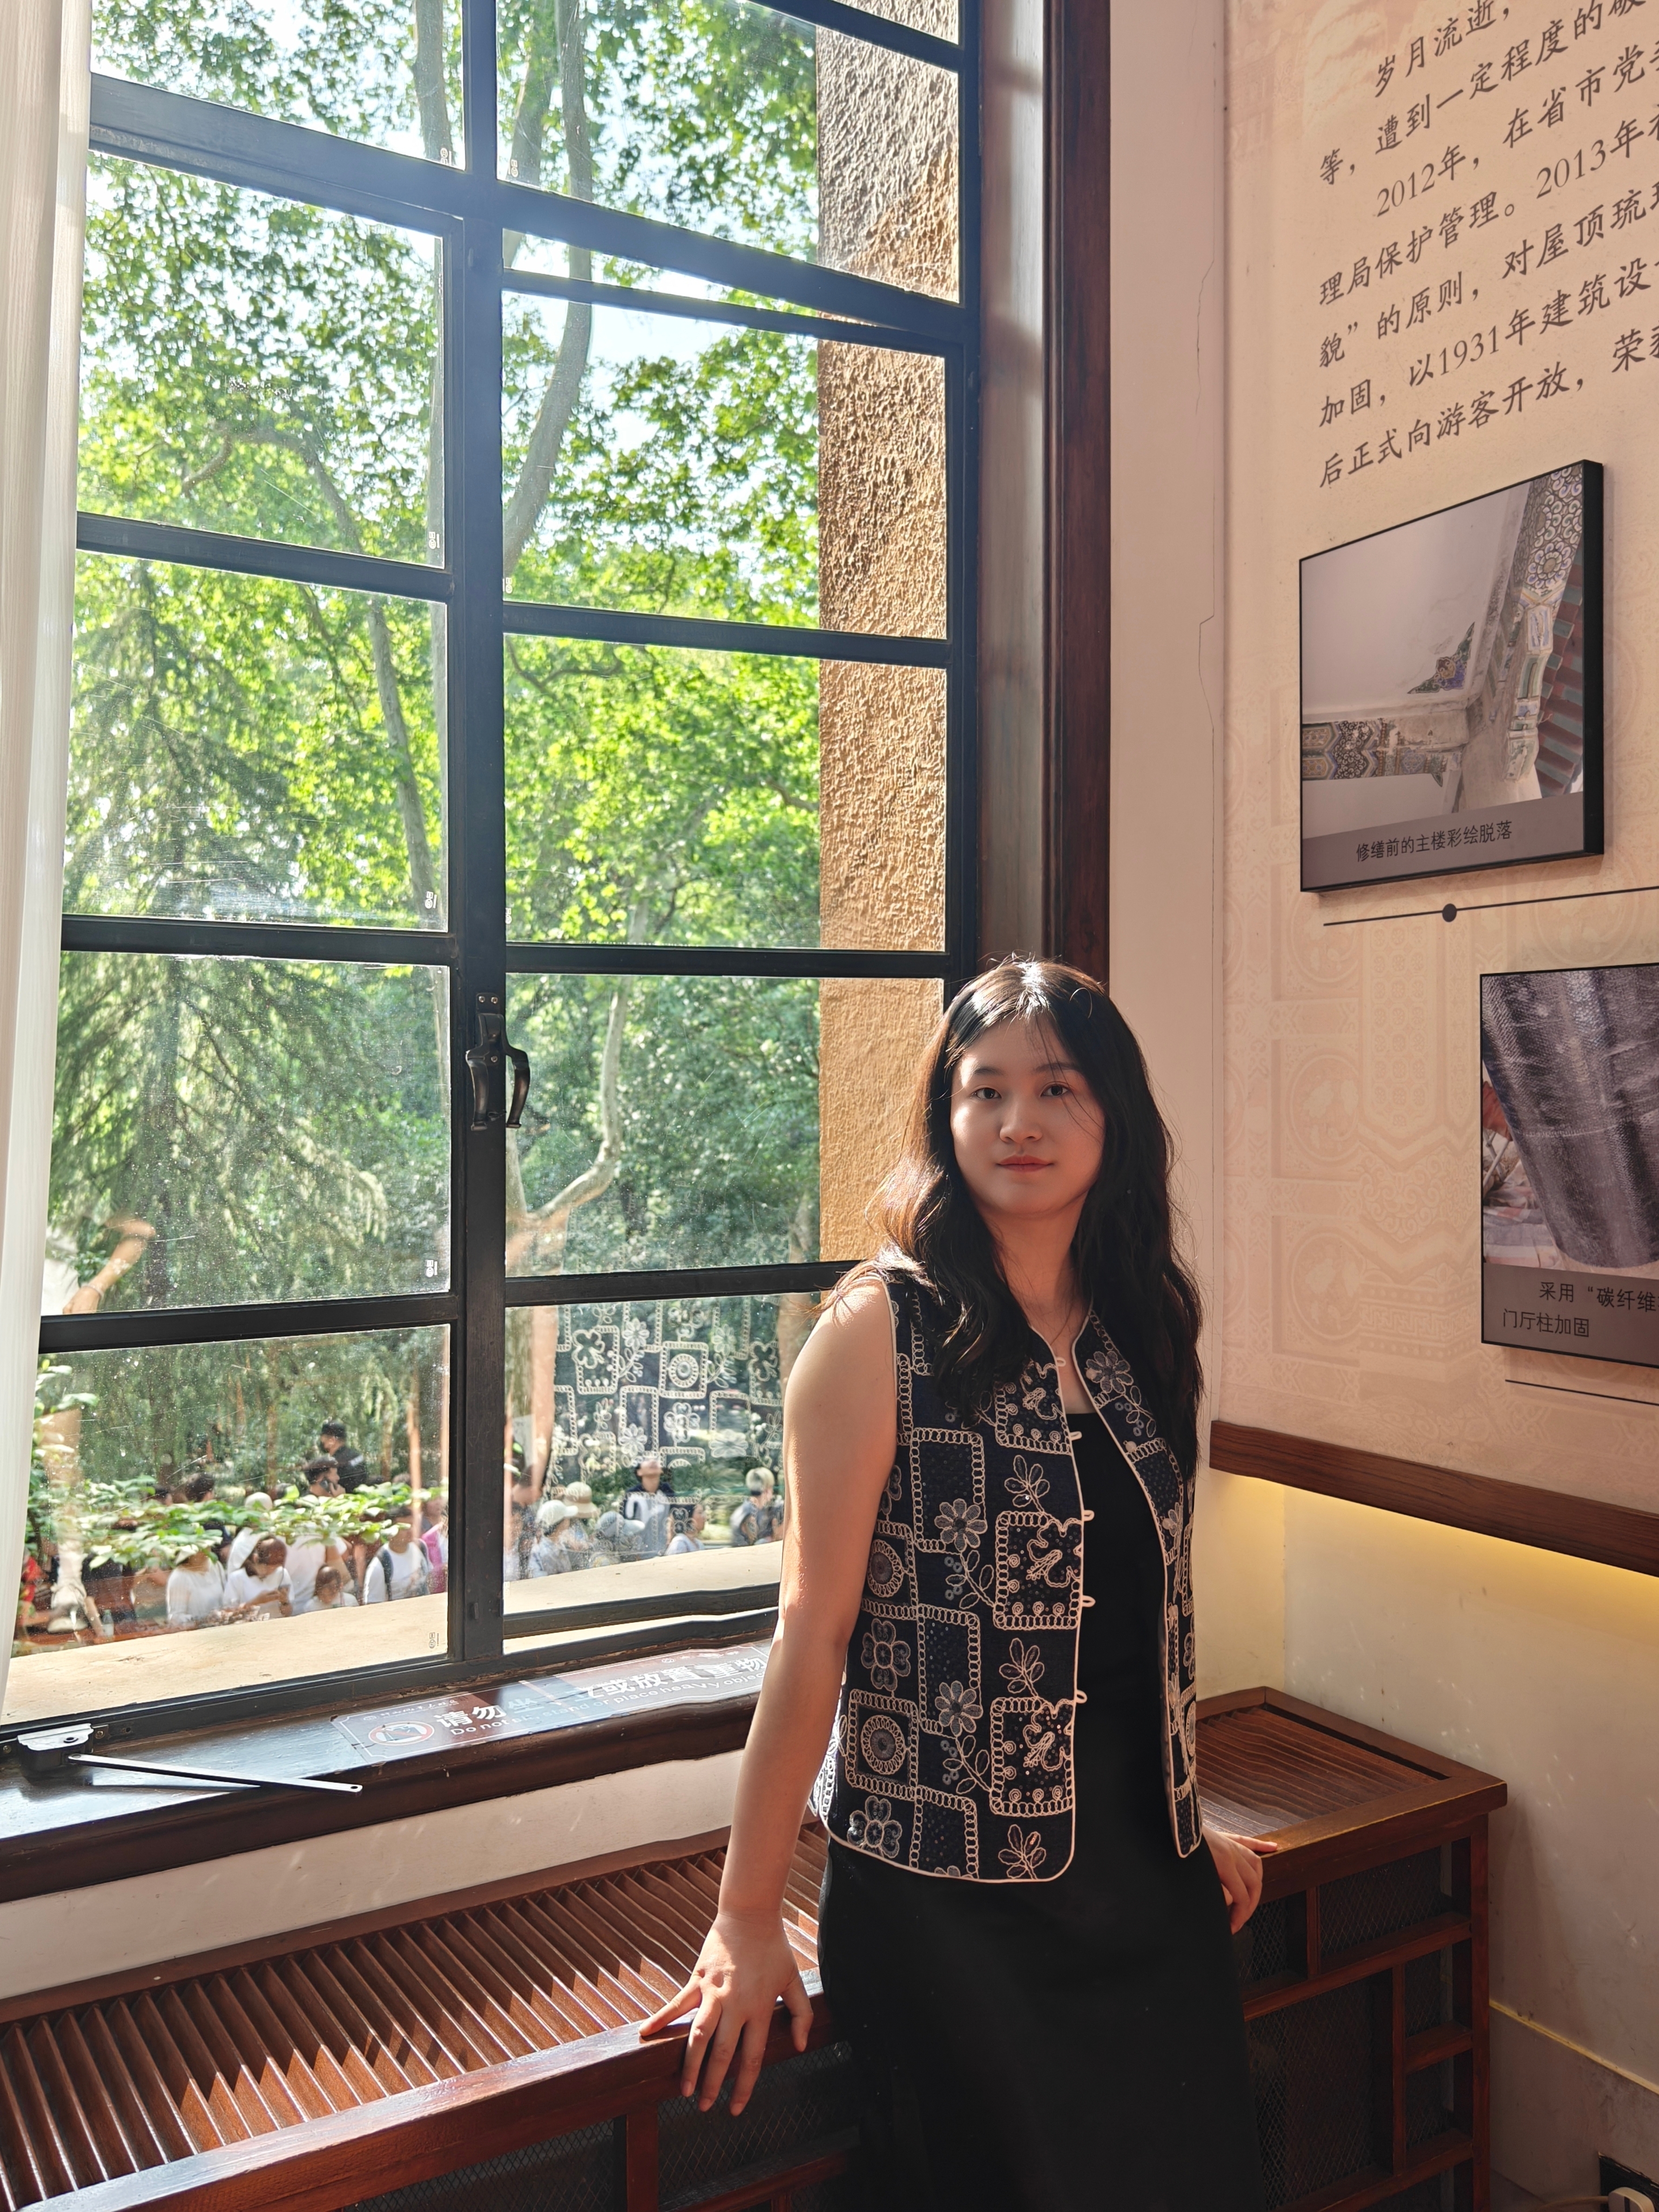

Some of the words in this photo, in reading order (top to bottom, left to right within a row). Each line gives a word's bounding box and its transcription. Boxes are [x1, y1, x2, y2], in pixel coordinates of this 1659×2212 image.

[1356, 820, 1513, 862] 修缮前的主楼彩绘脱落
[1539, 1282, 1659, 1312] 采用“碳纤维
[1503, 1309, 1589, 1337] 门厅柱加固
[480, 1719, 510, 1729] not
[659, 1682, 720, 1693] heavy
[723, 1671, 765, 1685] objec
